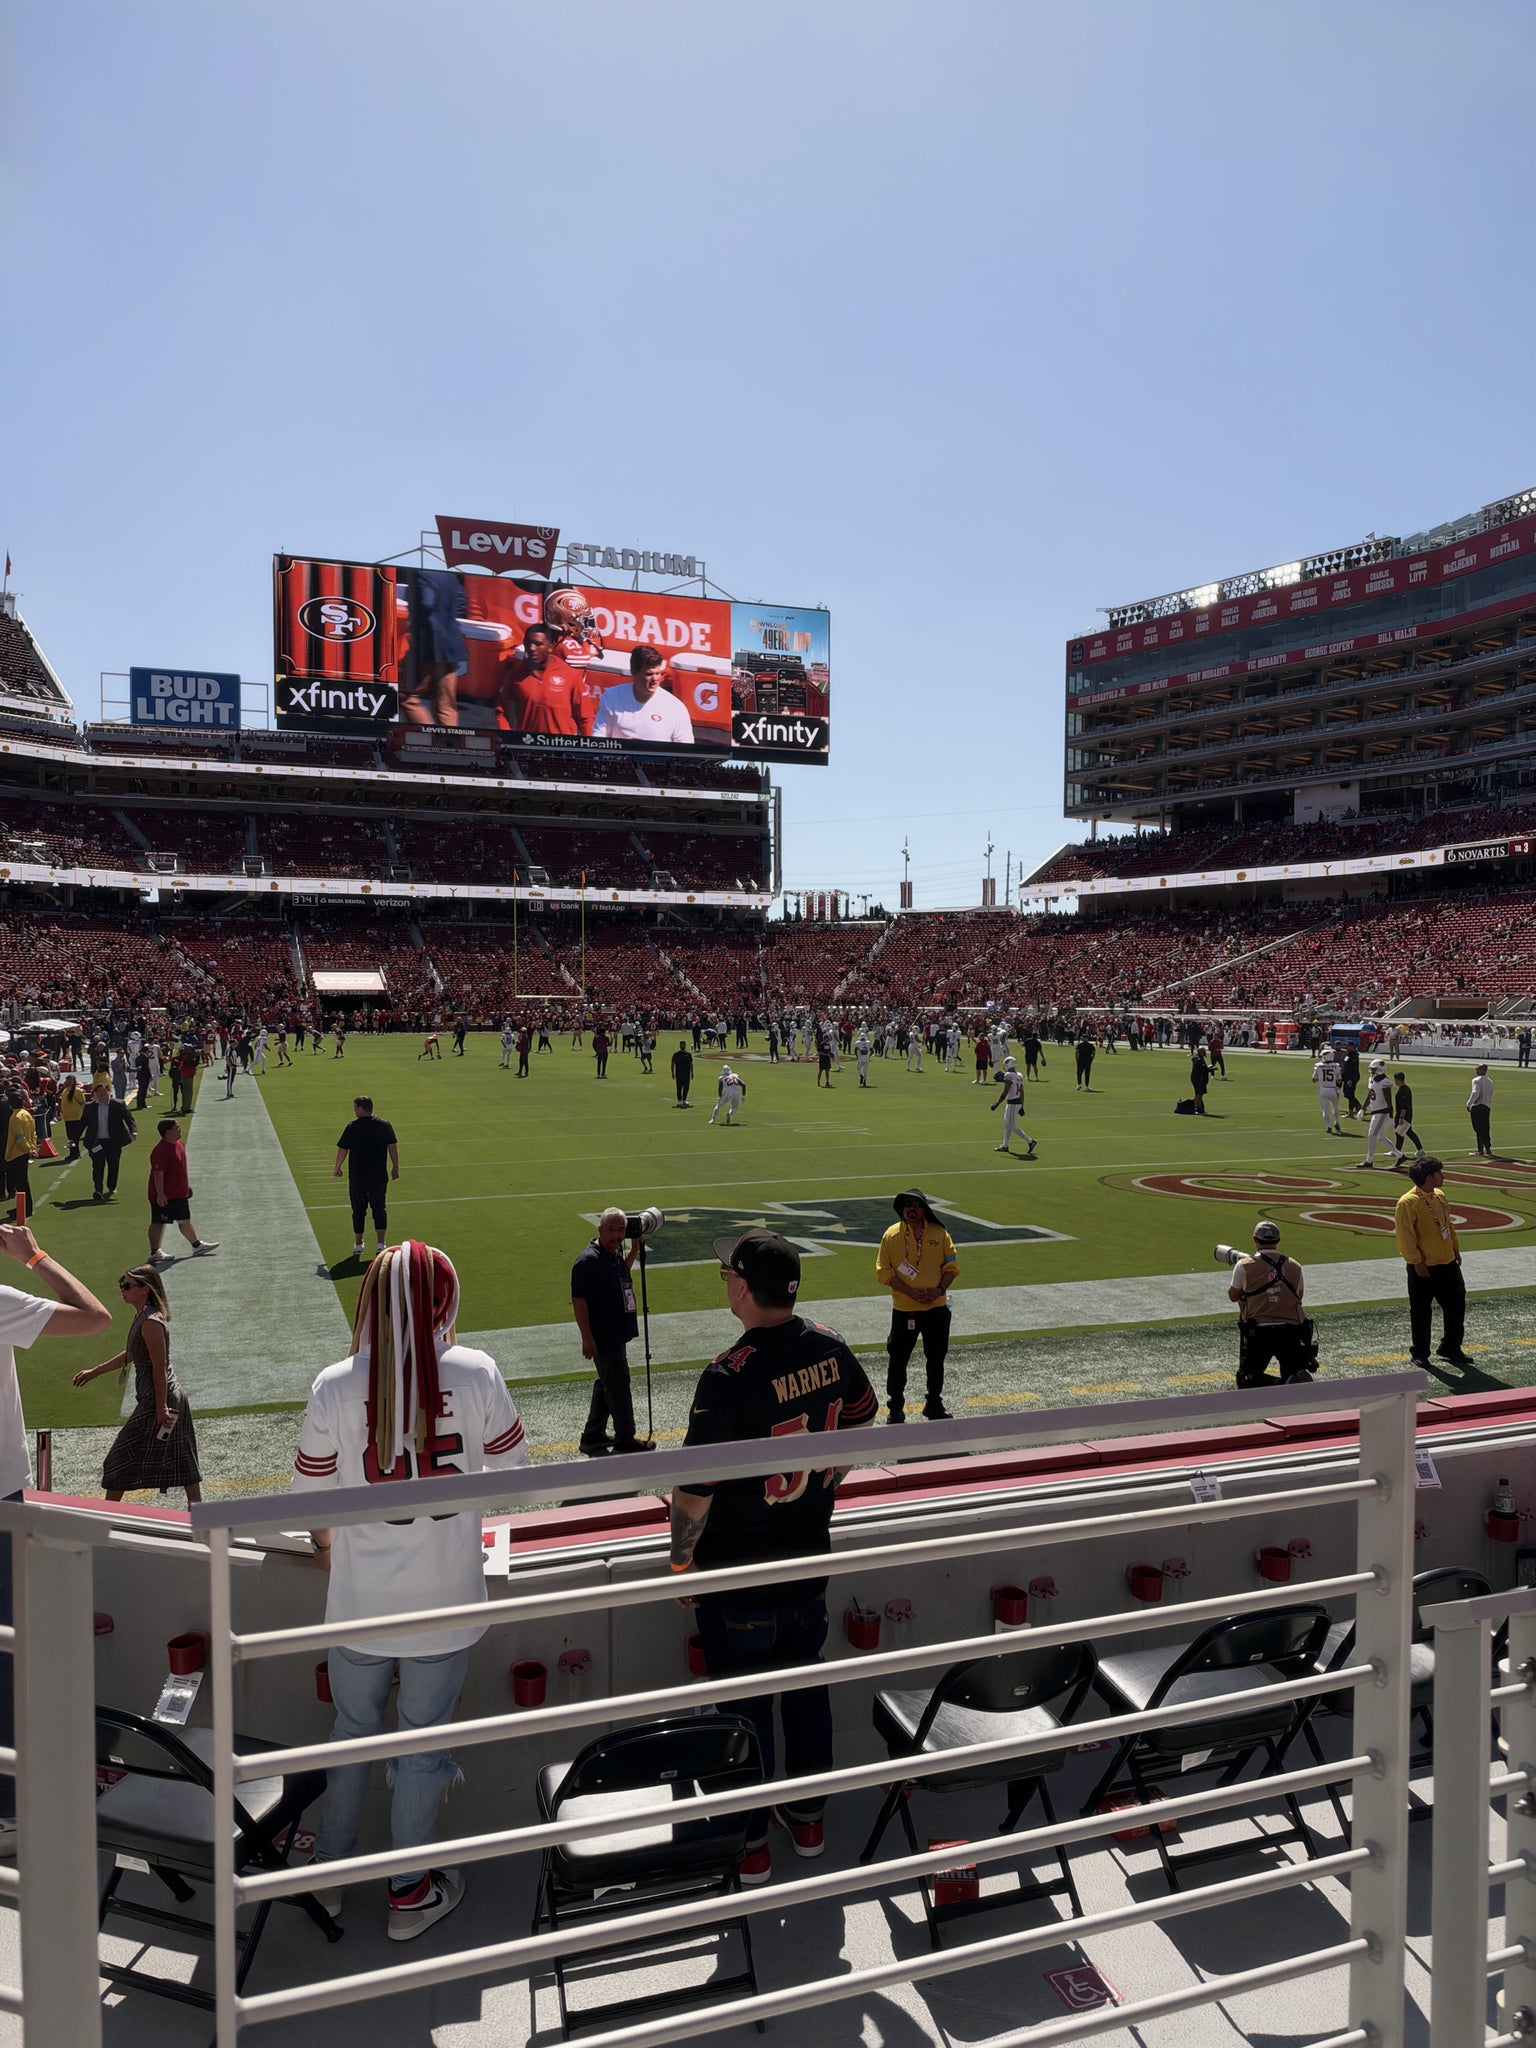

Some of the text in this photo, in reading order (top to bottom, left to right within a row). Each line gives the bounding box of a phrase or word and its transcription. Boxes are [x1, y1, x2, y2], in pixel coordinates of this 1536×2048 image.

[1490, 539, 1520, 559] MONTANA
[566, 542, 697, 577] STADIUM
[1409, 570, 1428, 584] LOTT
[1331, 588, 1352, 601] JONES
[1290, 596, 1318, 611] JOHNSON
[1251, 605, 1278, 620] JOHNSON
[514, 594, 711, 652] GORADE
[763, 629, 791, 651] 49ERS
[792, 631, 812, 653] APP
[1378, 626, 1417, 644] BILL WALSH
[1116, 640, 1133, 652] CLARK
[1305, 640, 1355, 658] GEORGE SEIFERT
[151, 674, 221, 700] BUD
[289, 682, 387, 716] xfinity
[136, 697, 235, 725] LIGHT
[447, 728, 476, 737] STADIUM
[741, 721, 820, 748] xfinity
[537, 735, 623, 750] Sutter Health
[1458, 846, 1505, 861] NOVARTIS
[1523, 842, 1529, 853] 3
[374, 898, 410, 907] verizon
[600, 904, 626, 912] NetApp
[1322, 1069, 1334, 1082] 15
[771, 1356, 841, 1404] WARNER
